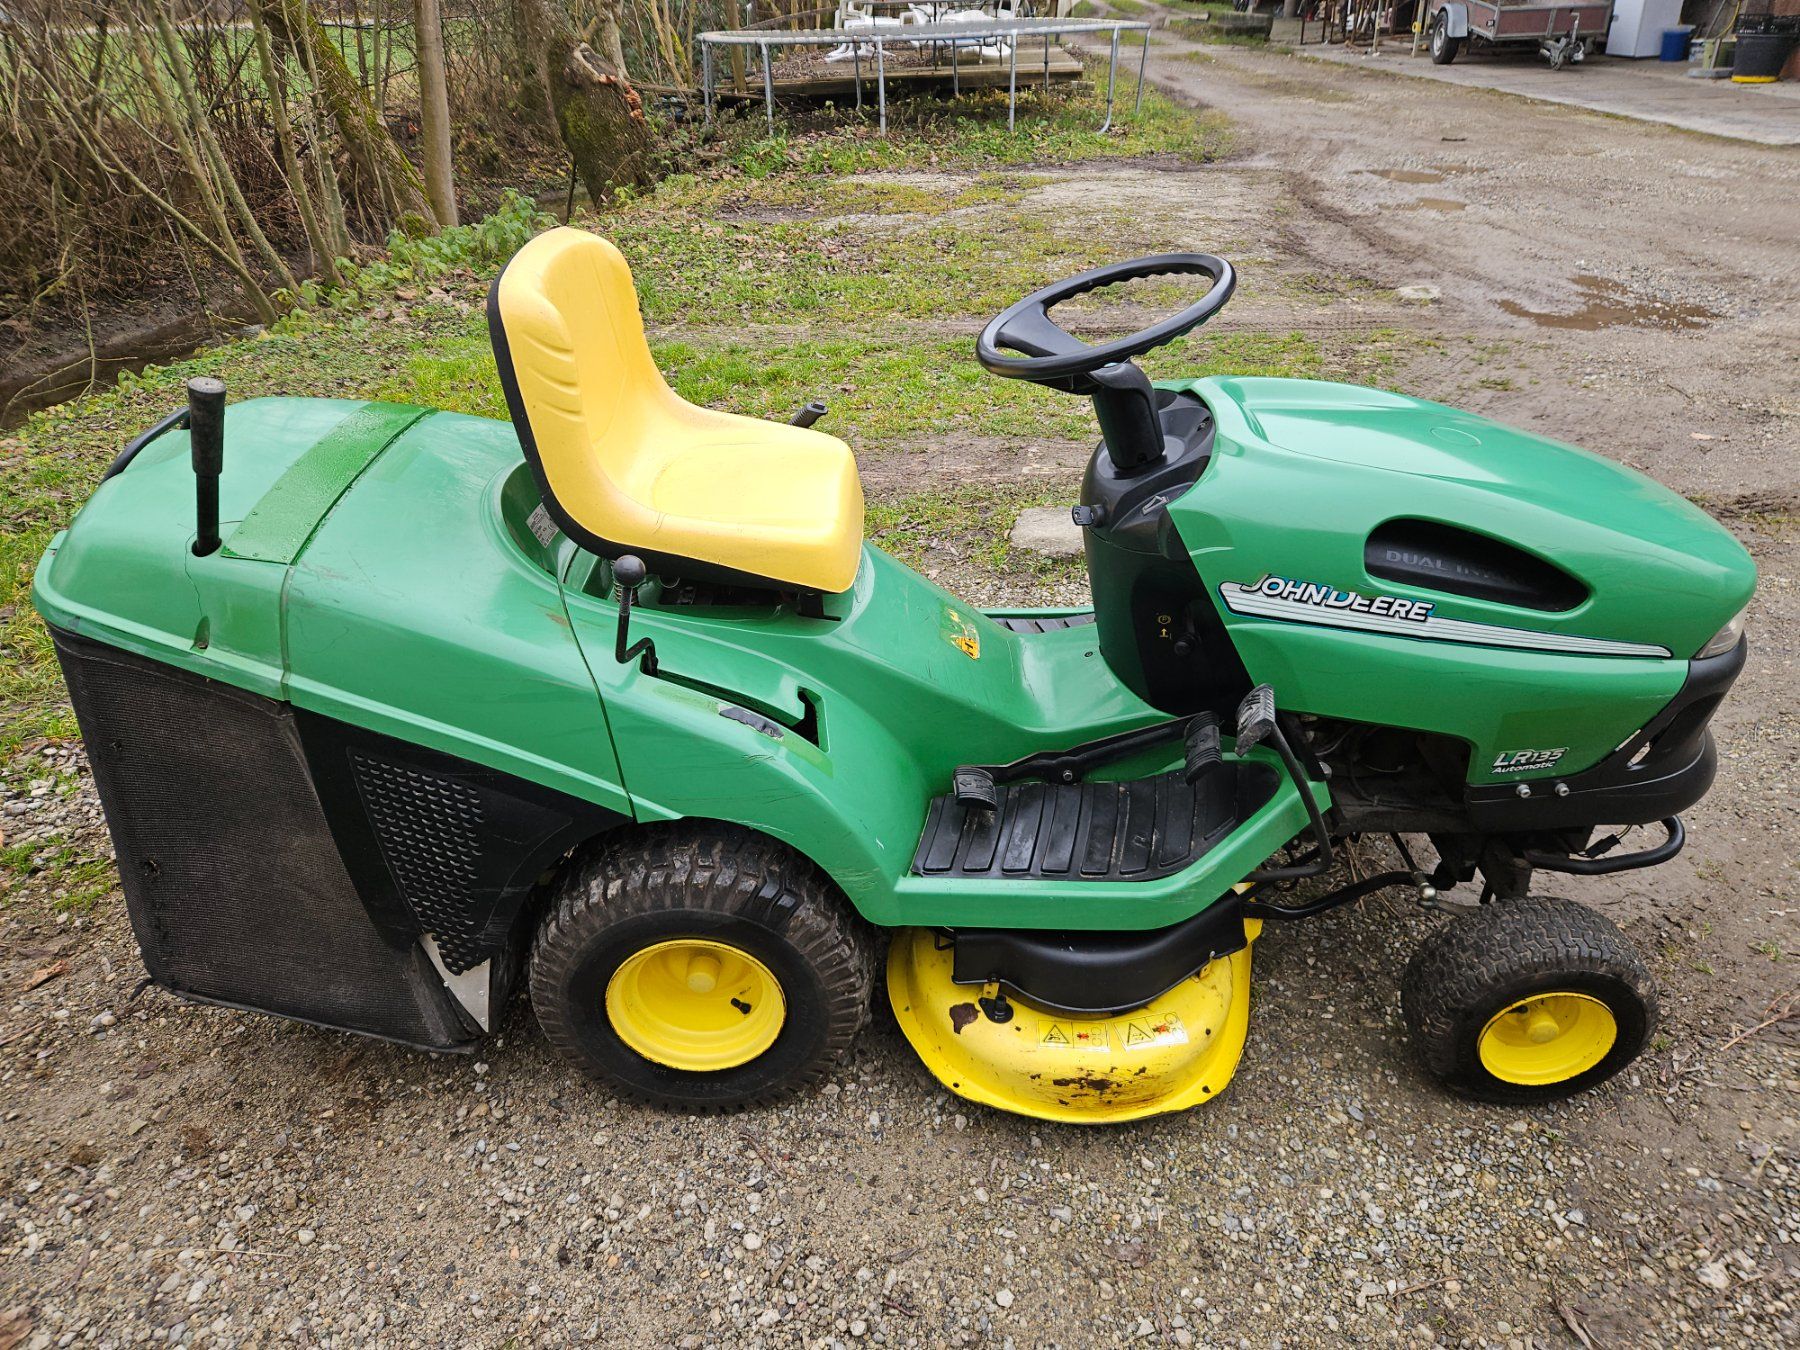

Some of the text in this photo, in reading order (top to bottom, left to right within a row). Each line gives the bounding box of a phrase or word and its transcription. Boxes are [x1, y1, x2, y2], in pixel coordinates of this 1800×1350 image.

[1386, 549, 1448, 571] DUAL
[1491, 761, 1555, 773] Automatic
[1493, 748, 1566, 767] LR135
